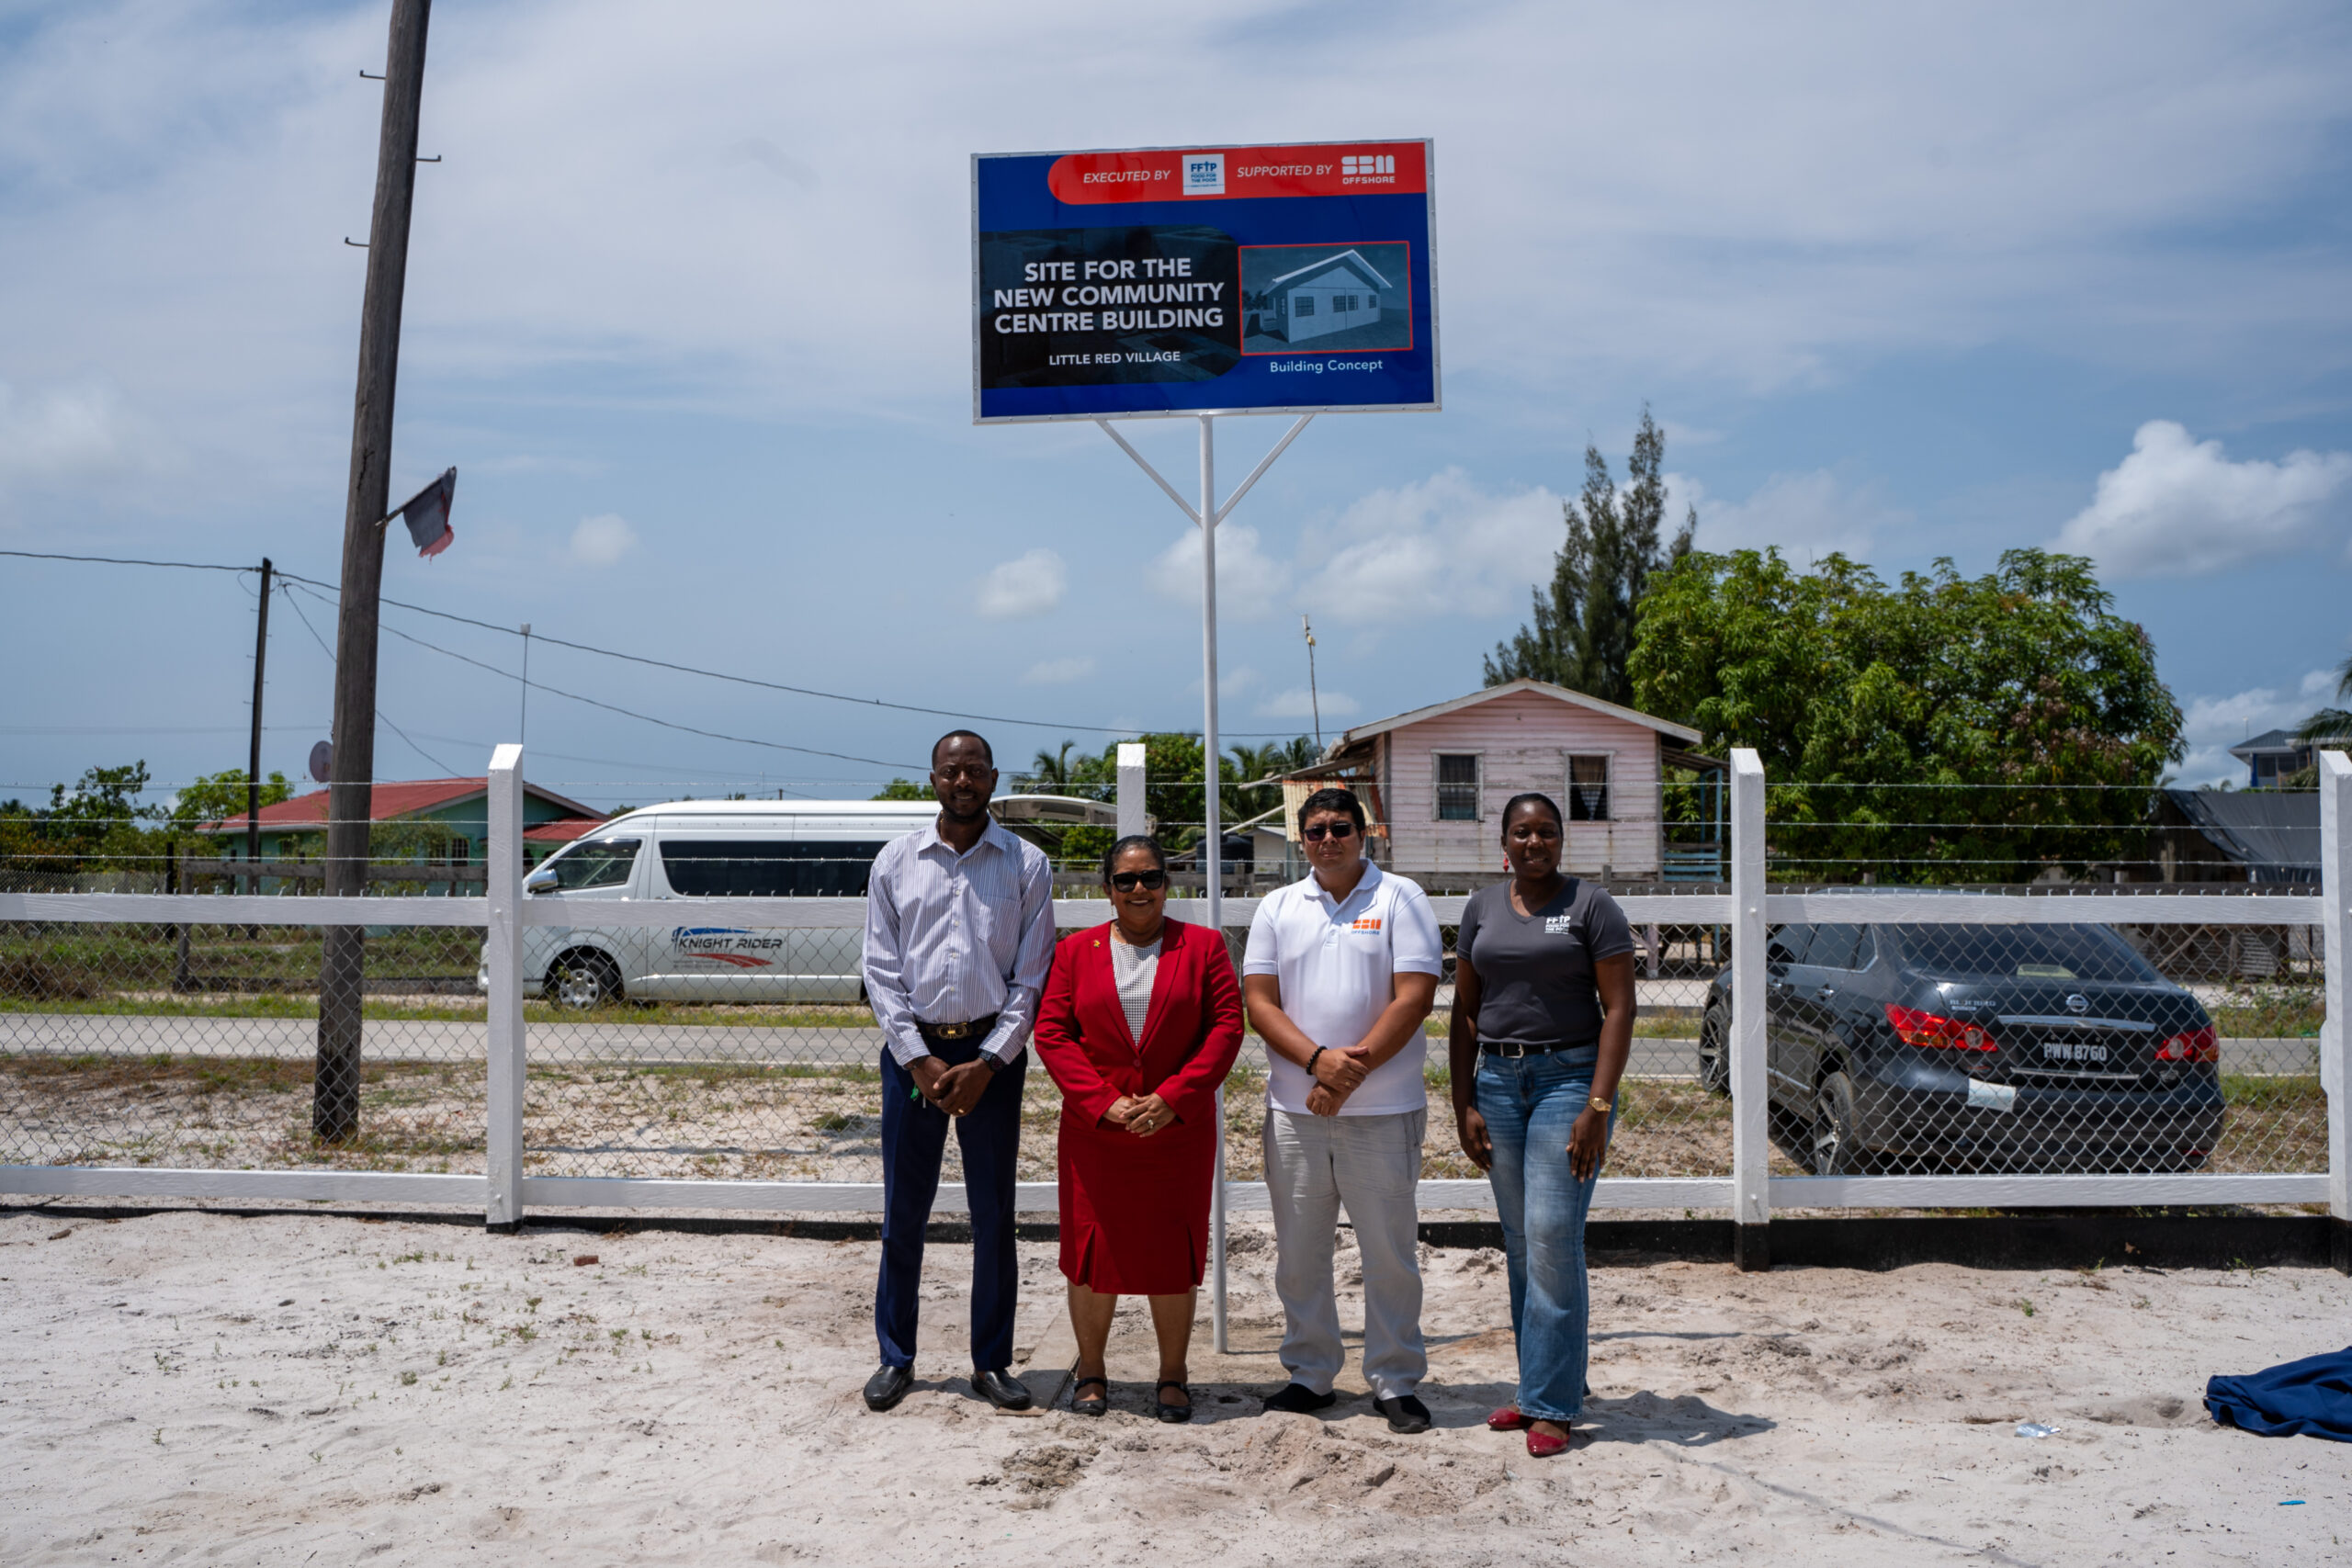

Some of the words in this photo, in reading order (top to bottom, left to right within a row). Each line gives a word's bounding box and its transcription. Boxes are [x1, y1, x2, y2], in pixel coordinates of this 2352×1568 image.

[1082, 171, 1151, 184] EXECUTED
[1154, 170, 1171, 181] BY
[1237, 165, 1314, 178] SUPPORTED
[1315, 164, 1333, 175] BY
[1342, 175, 1396, 185] OFFSHORE
[1024, 262, 1076, 282] SITE
[1084, 260, 1136, 280] FOR
[1142, 258, 1192, 277] THE
[994, 287, 1055, 309] NEW
[1062, 282, 1225, 306] COMMUNITY
[994, 311, 1094, 334] CENTRE
[1102, 307, 1224, 331] BUILDING
[1049, 354, 1091, 366] LITTLE
[1095, 353, 1122, 365] RED
[1125, 351, 1181, 364] VILLAGE
[1270, 360, 1323, 374] Building
[1328, 360, 1383, 373] Concept
[736, 938, 783, 949] RIDER
[2074, 1043, 2108, 1062] 8760
